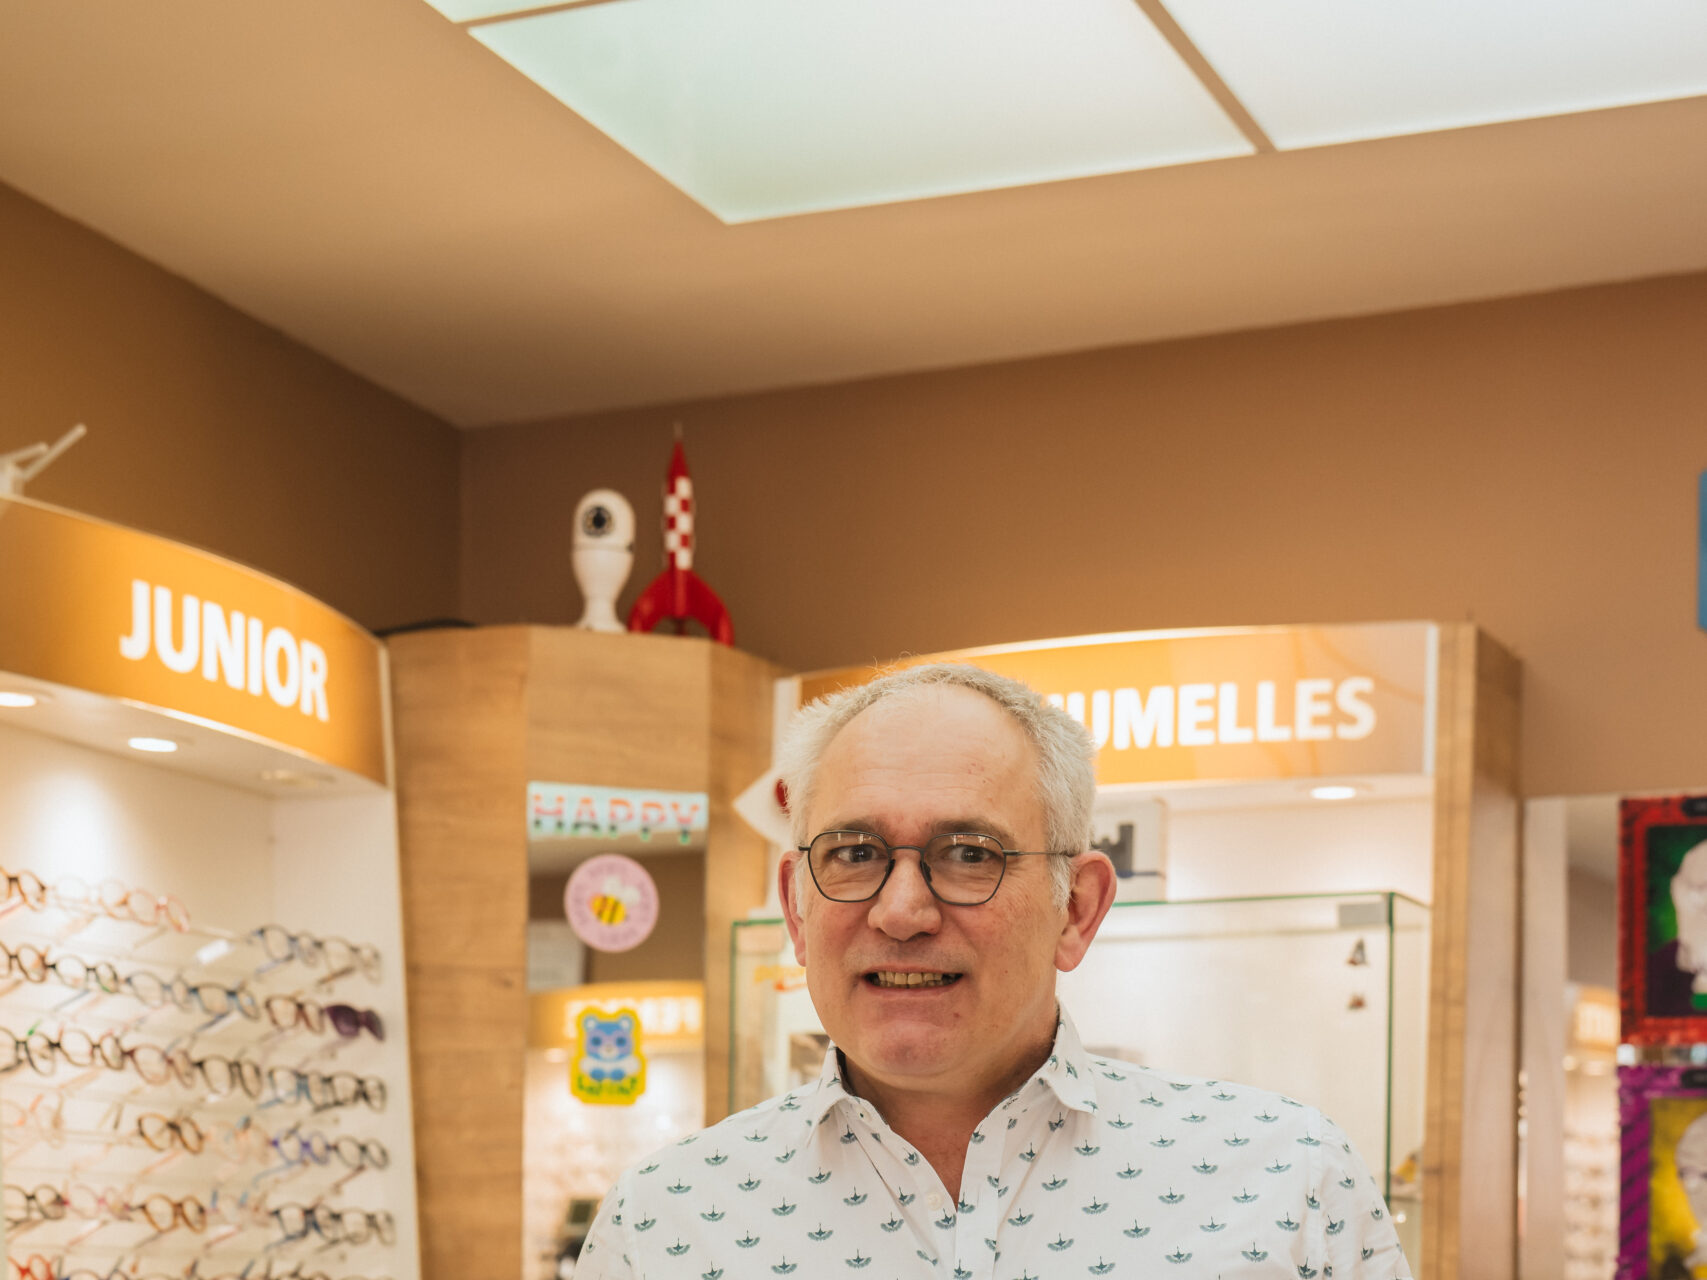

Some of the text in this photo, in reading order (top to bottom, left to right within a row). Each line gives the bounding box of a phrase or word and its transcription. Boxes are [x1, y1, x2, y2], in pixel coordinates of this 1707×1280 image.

[119, 578, 330, 723] JUNIOR
[1046, 676, 1377, 750] UMELLES
[533, 794, 700, 846] HAPPY
